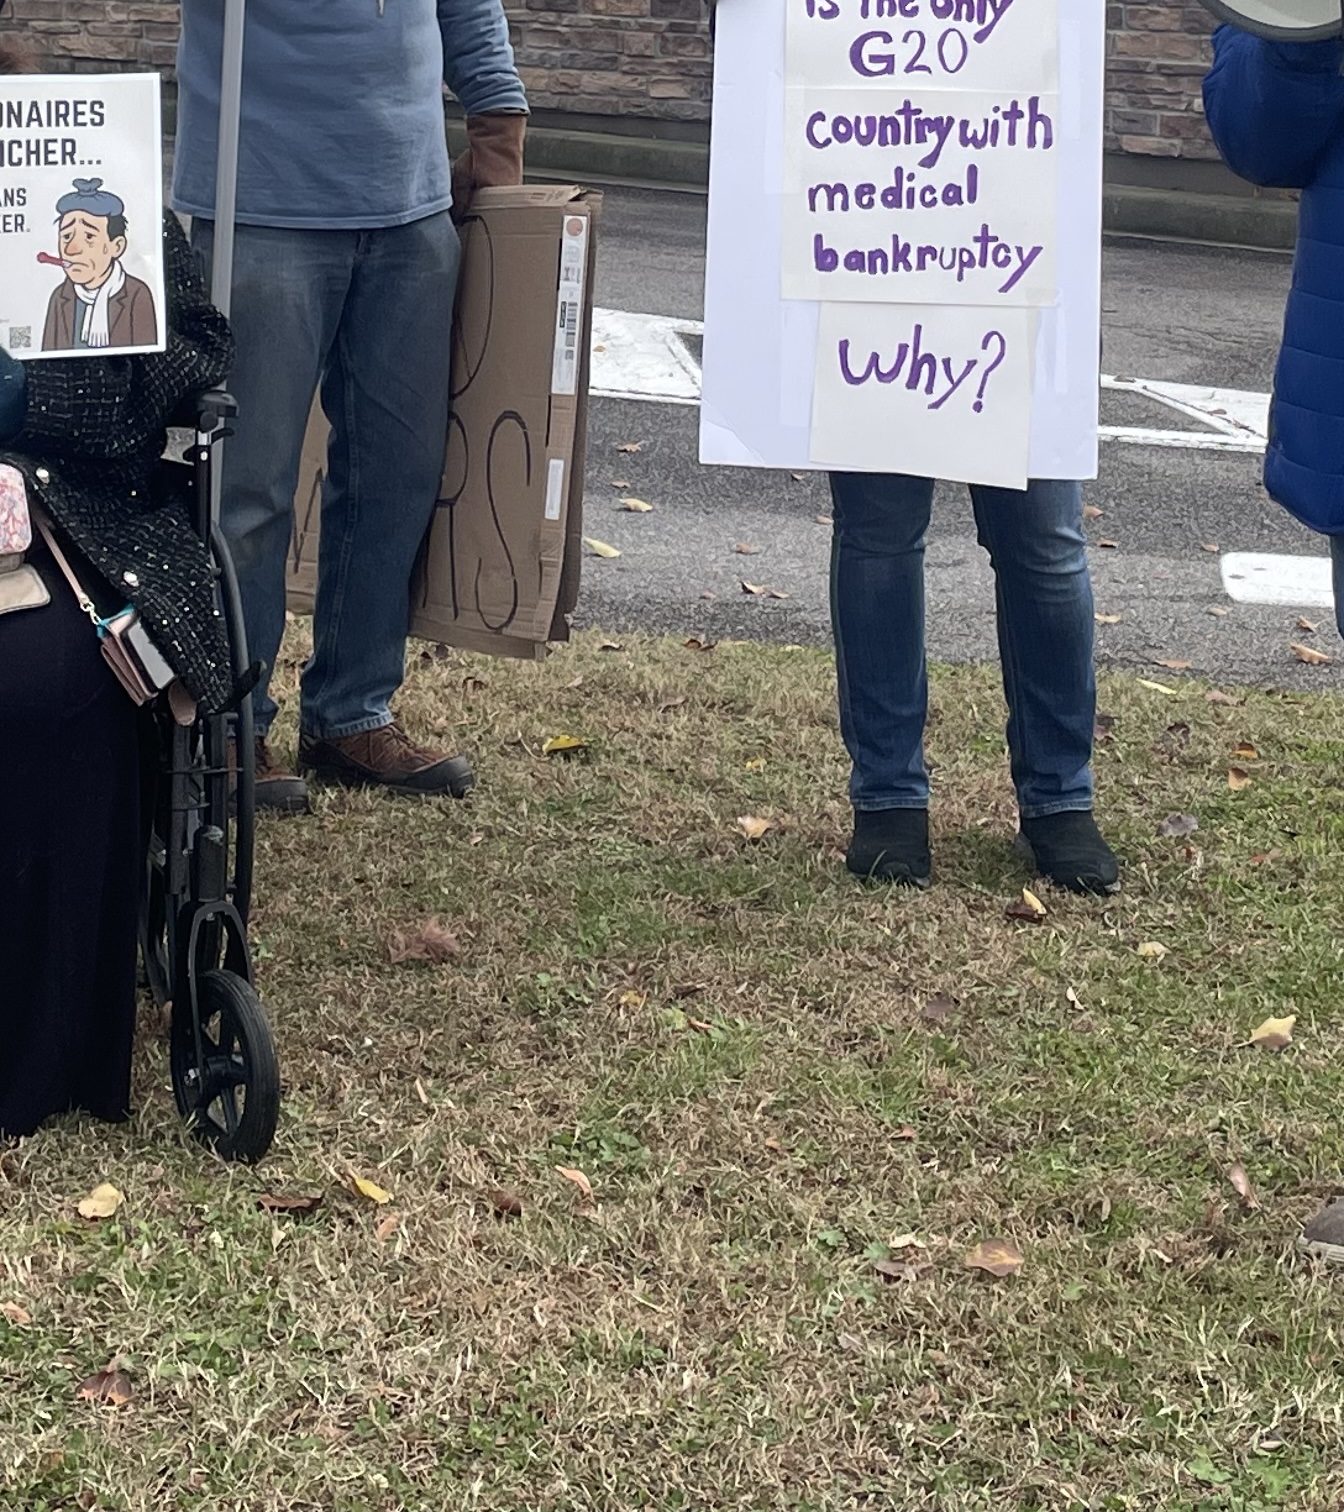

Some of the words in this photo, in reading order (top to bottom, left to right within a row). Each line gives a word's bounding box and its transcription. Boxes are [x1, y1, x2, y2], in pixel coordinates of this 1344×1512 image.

[848, 29, 969, 77] G20
[806, 99, 955, 169] country
[958, 96, 1054, 150] with
[808, 164, 979, 213] medical
[813, 223, 1044, 294] bankruptcy
